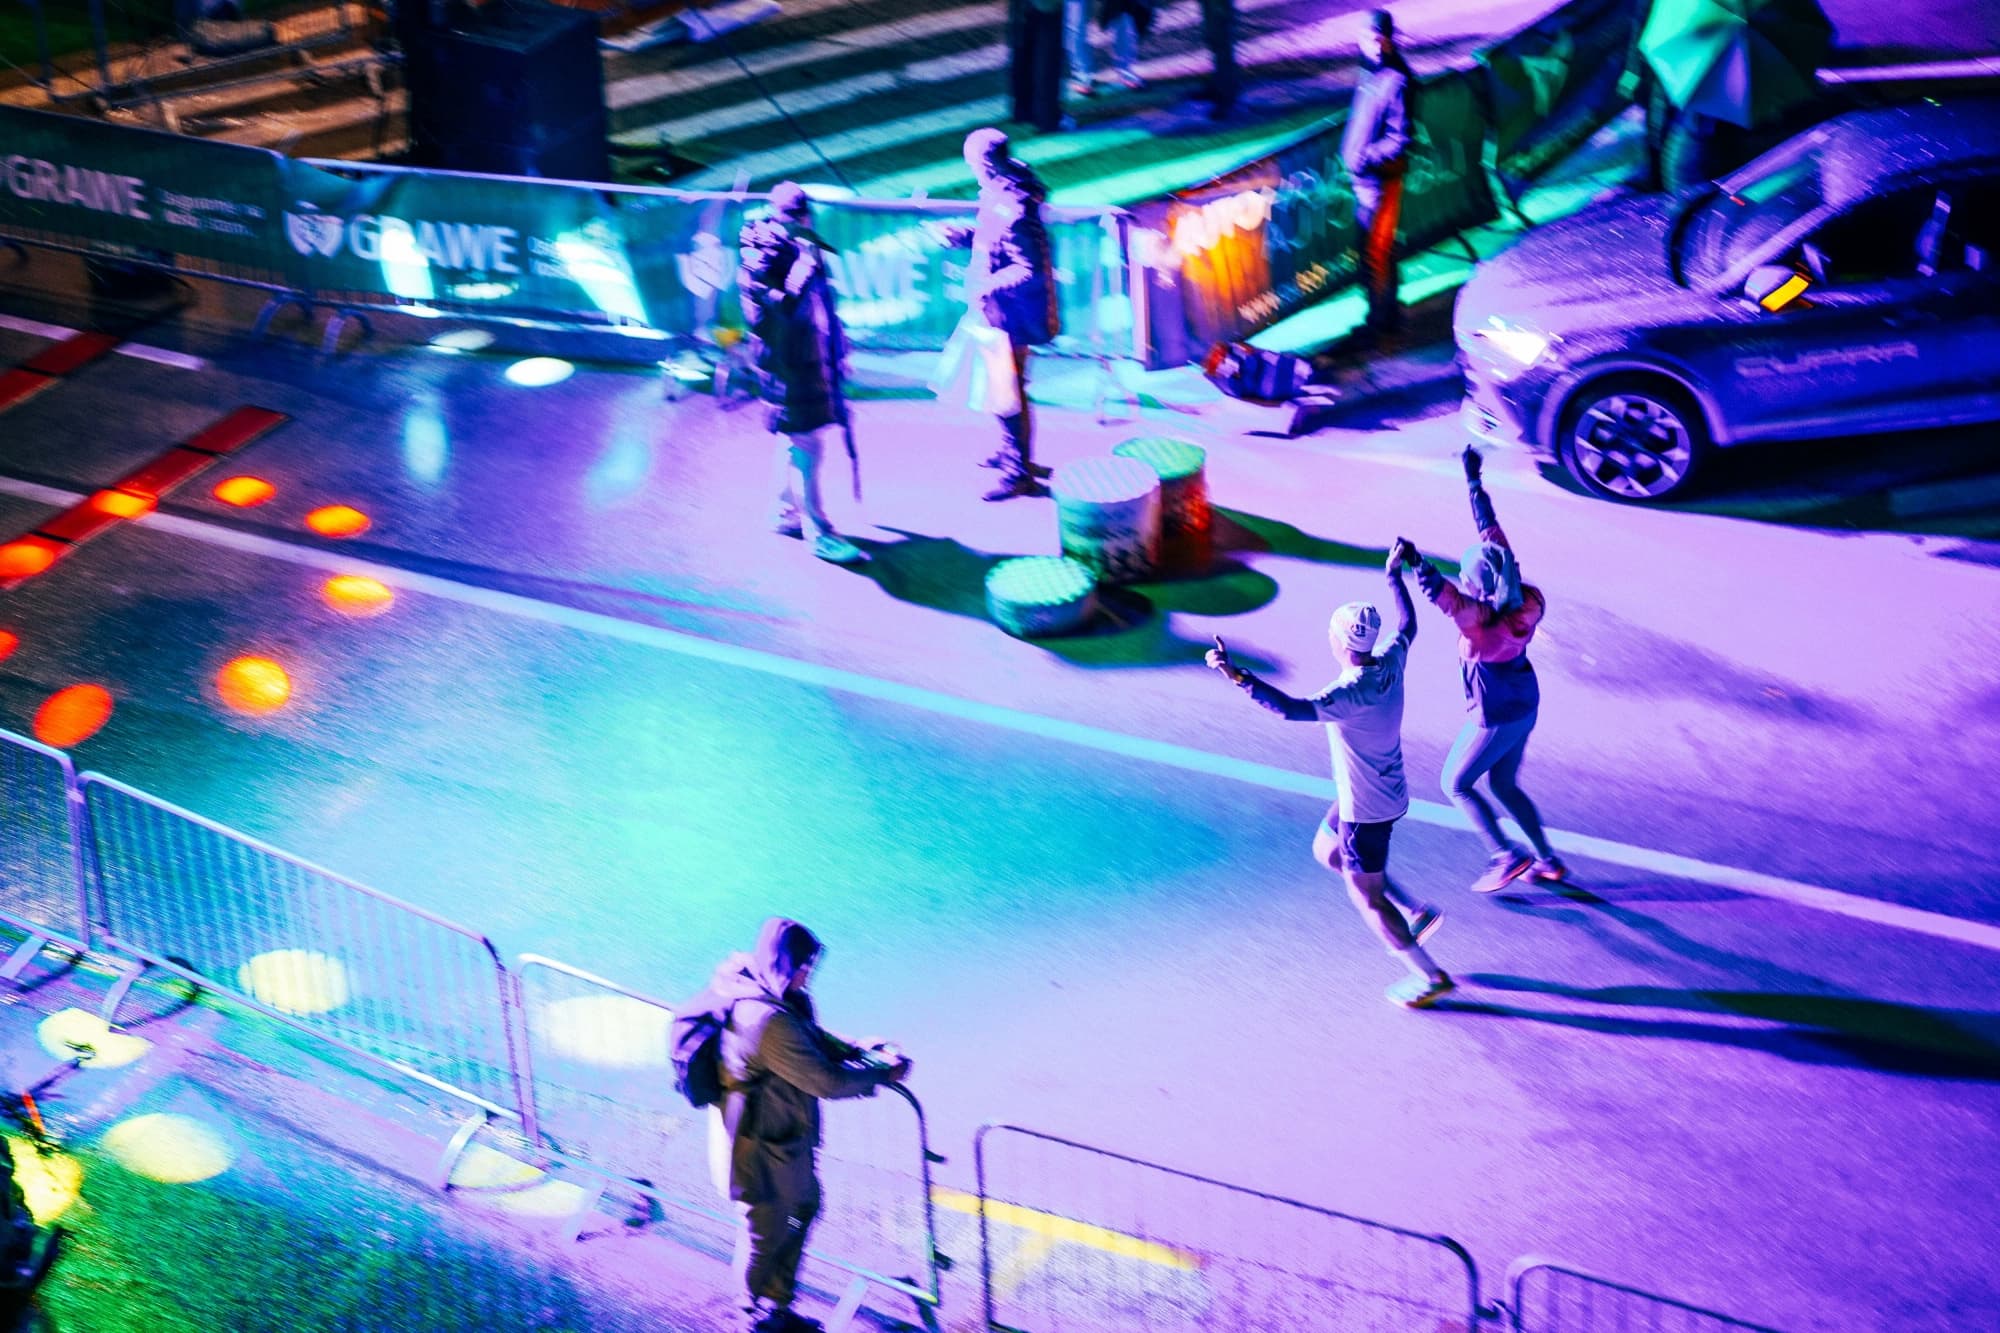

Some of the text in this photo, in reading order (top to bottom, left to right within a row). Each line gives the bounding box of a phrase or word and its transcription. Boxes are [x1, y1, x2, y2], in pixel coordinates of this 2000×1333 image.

[7, 154, 151, 221] GRAWE
[350, 213, 521, 275] GRAWE
[820, 248, 932, 304] AWE
